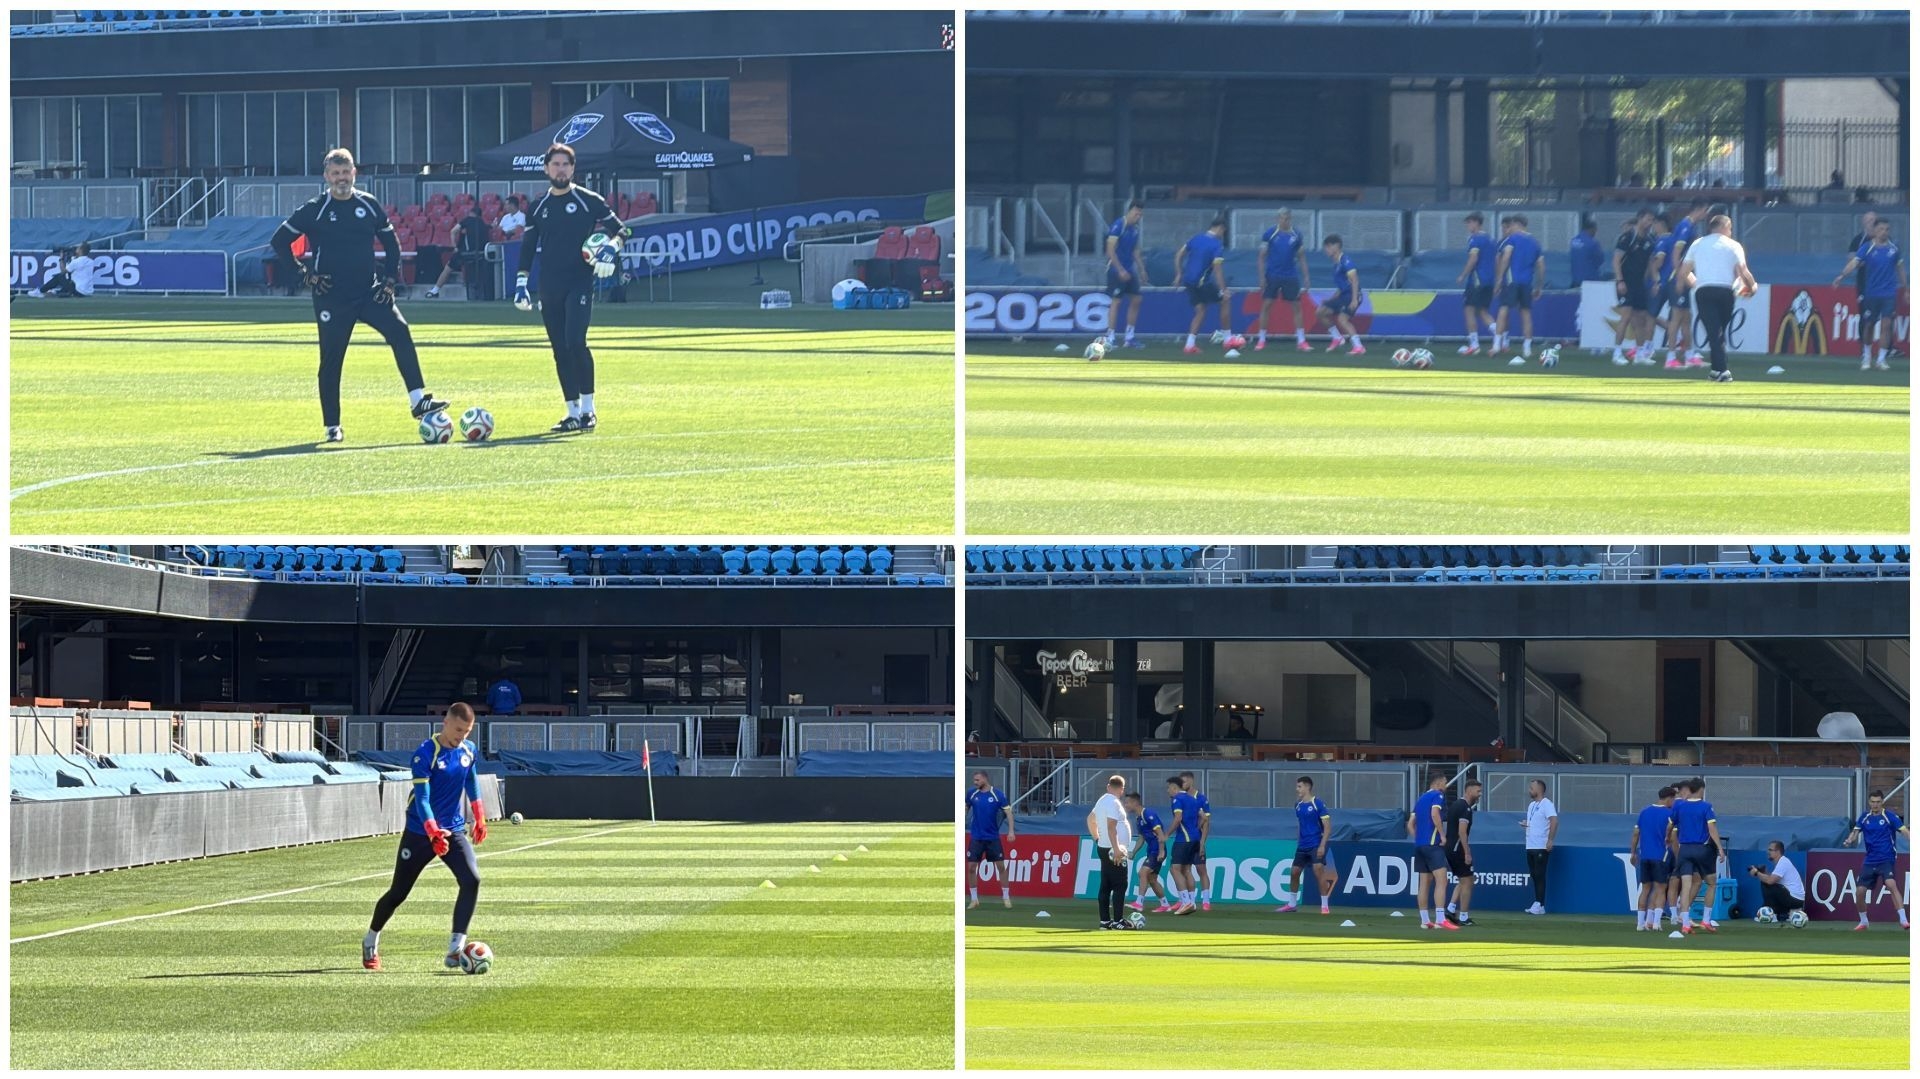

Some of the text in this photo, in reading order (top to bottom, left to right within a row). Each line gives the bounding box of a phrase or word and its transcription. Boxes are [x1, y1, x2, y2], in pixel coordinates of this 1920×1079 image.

[656, 152, 714, 162] EARTHQUAKES
[621, 227, 722, 270] WORLD
[727, 219, 781, 255] CUP
[43, 255, 140, 286] 226
[965, 292, 1112, 331] 2026
[1057, 675, 1087, 687] BEER
[976, 849, 1039, 882] ovin'
